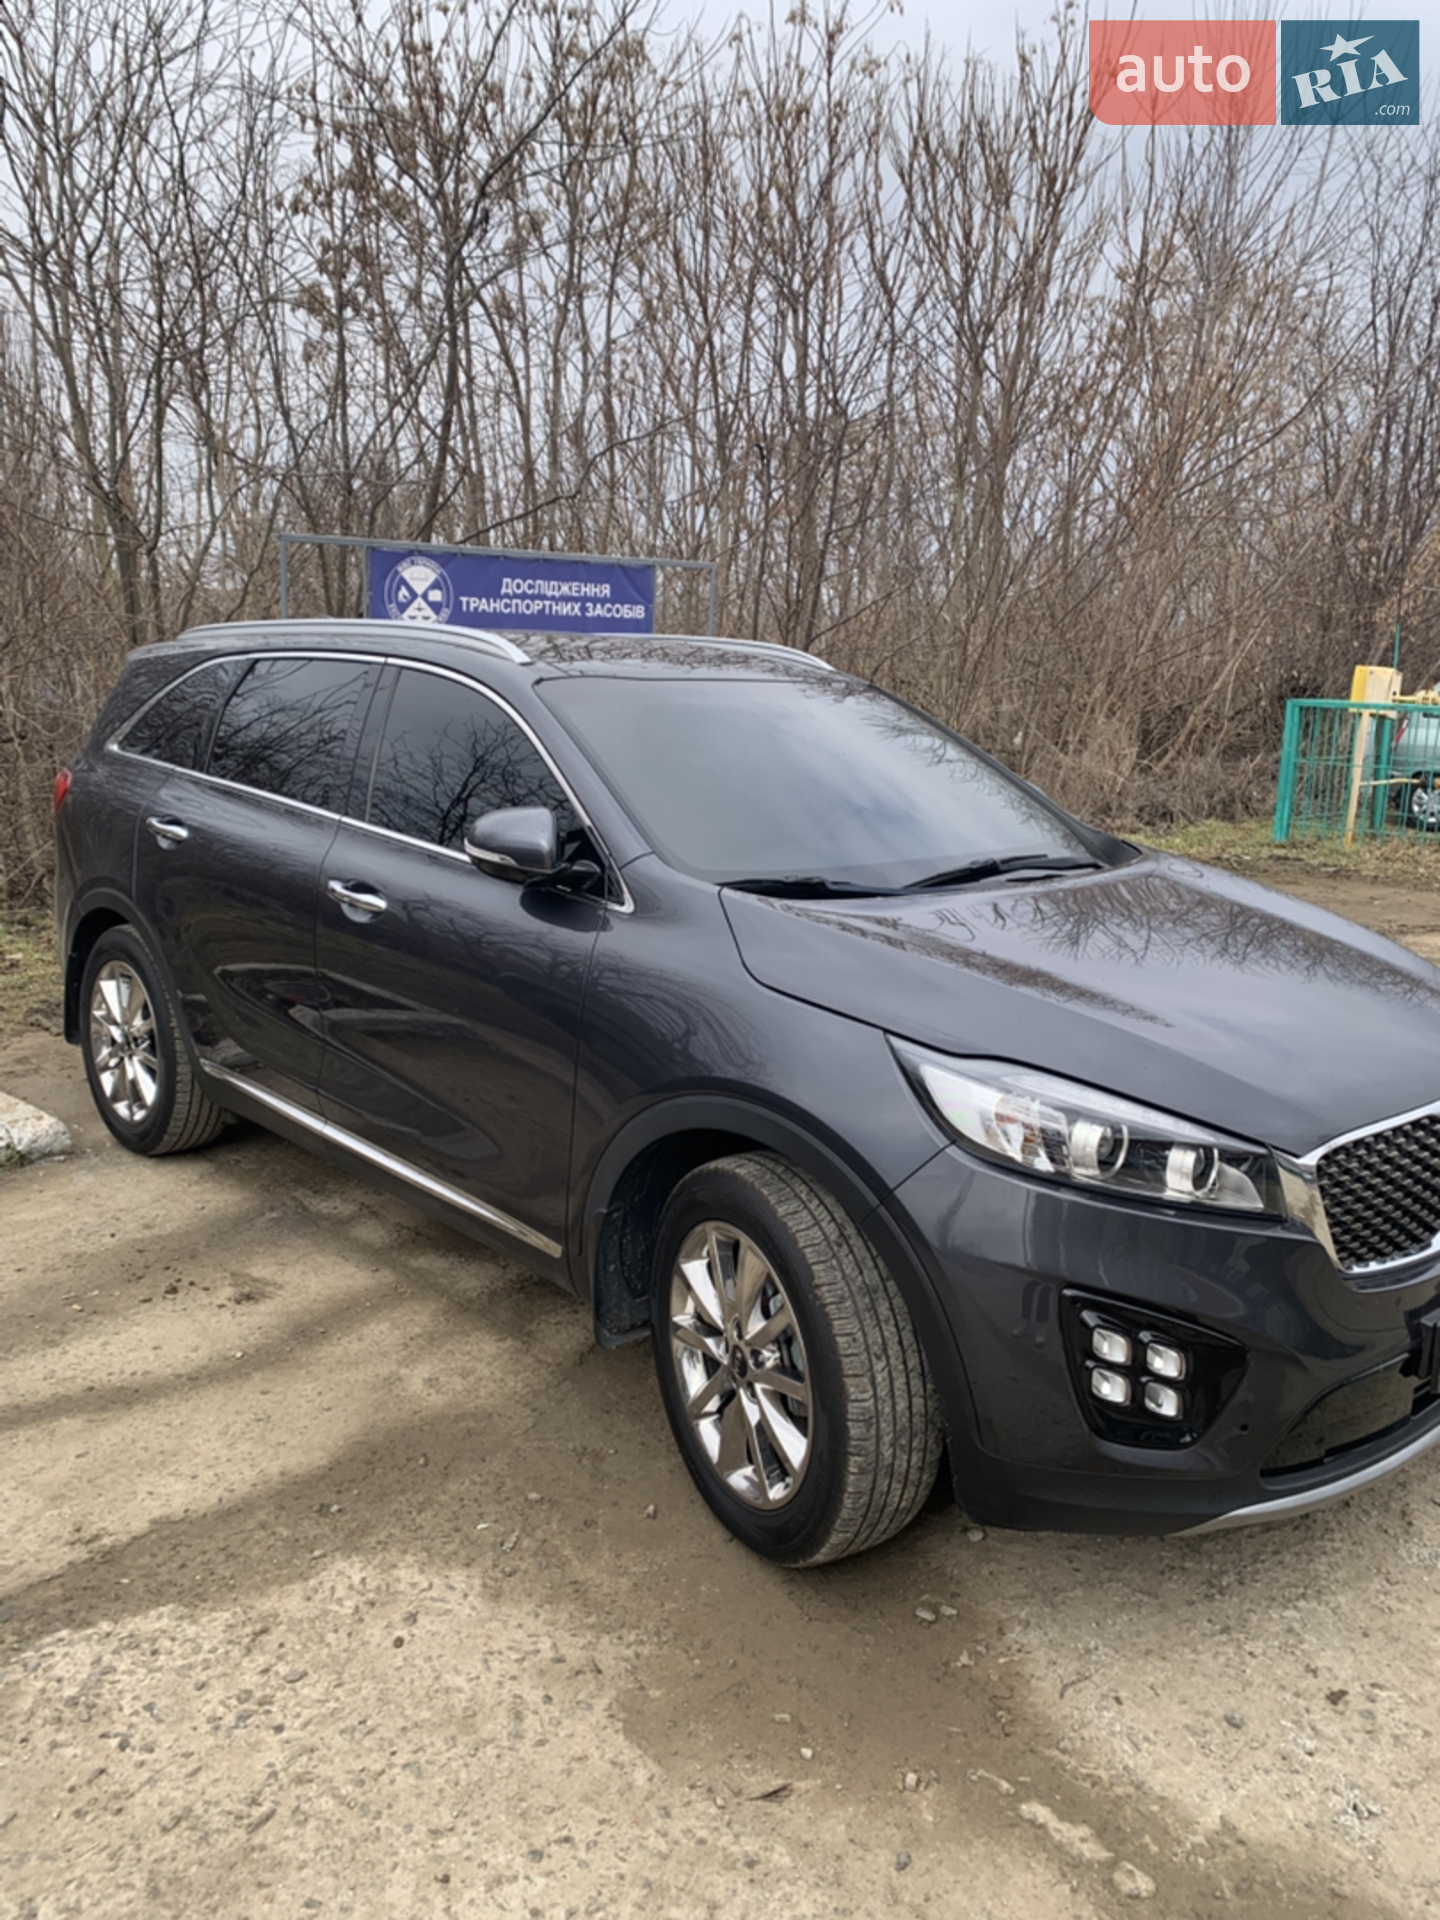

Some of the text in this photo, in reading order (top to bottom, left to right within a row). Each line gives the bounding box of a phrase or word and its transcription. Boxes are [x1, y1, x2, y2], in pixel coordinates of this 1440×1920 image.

[501, 577, 611, 598] ДОСЛІДЖЕННЯ
[460, 596, 582, 617] ТРАНСПОРТНИХ
[585, 602, 645, 619] ЗАСОБІВ
